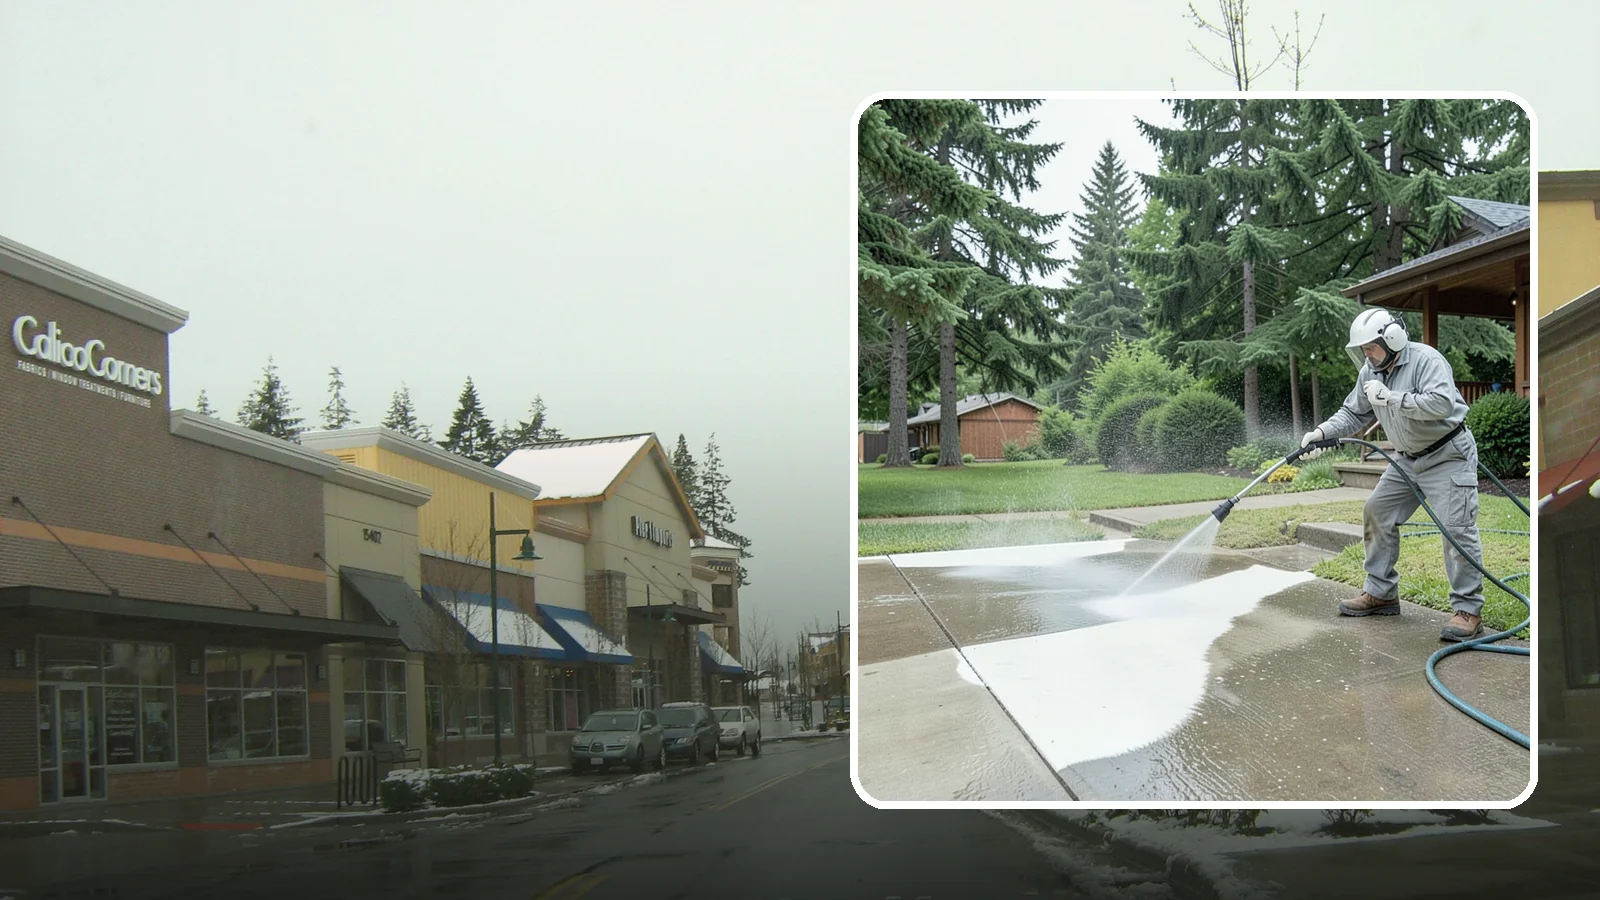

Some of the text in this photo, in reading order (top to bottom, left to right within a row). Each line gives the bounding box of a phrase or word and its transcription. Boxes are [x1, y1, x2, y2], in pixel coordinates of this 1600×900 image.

[17, 359, 151, 409] FABRICS WINDOW TREATMENTS FURNITURE
